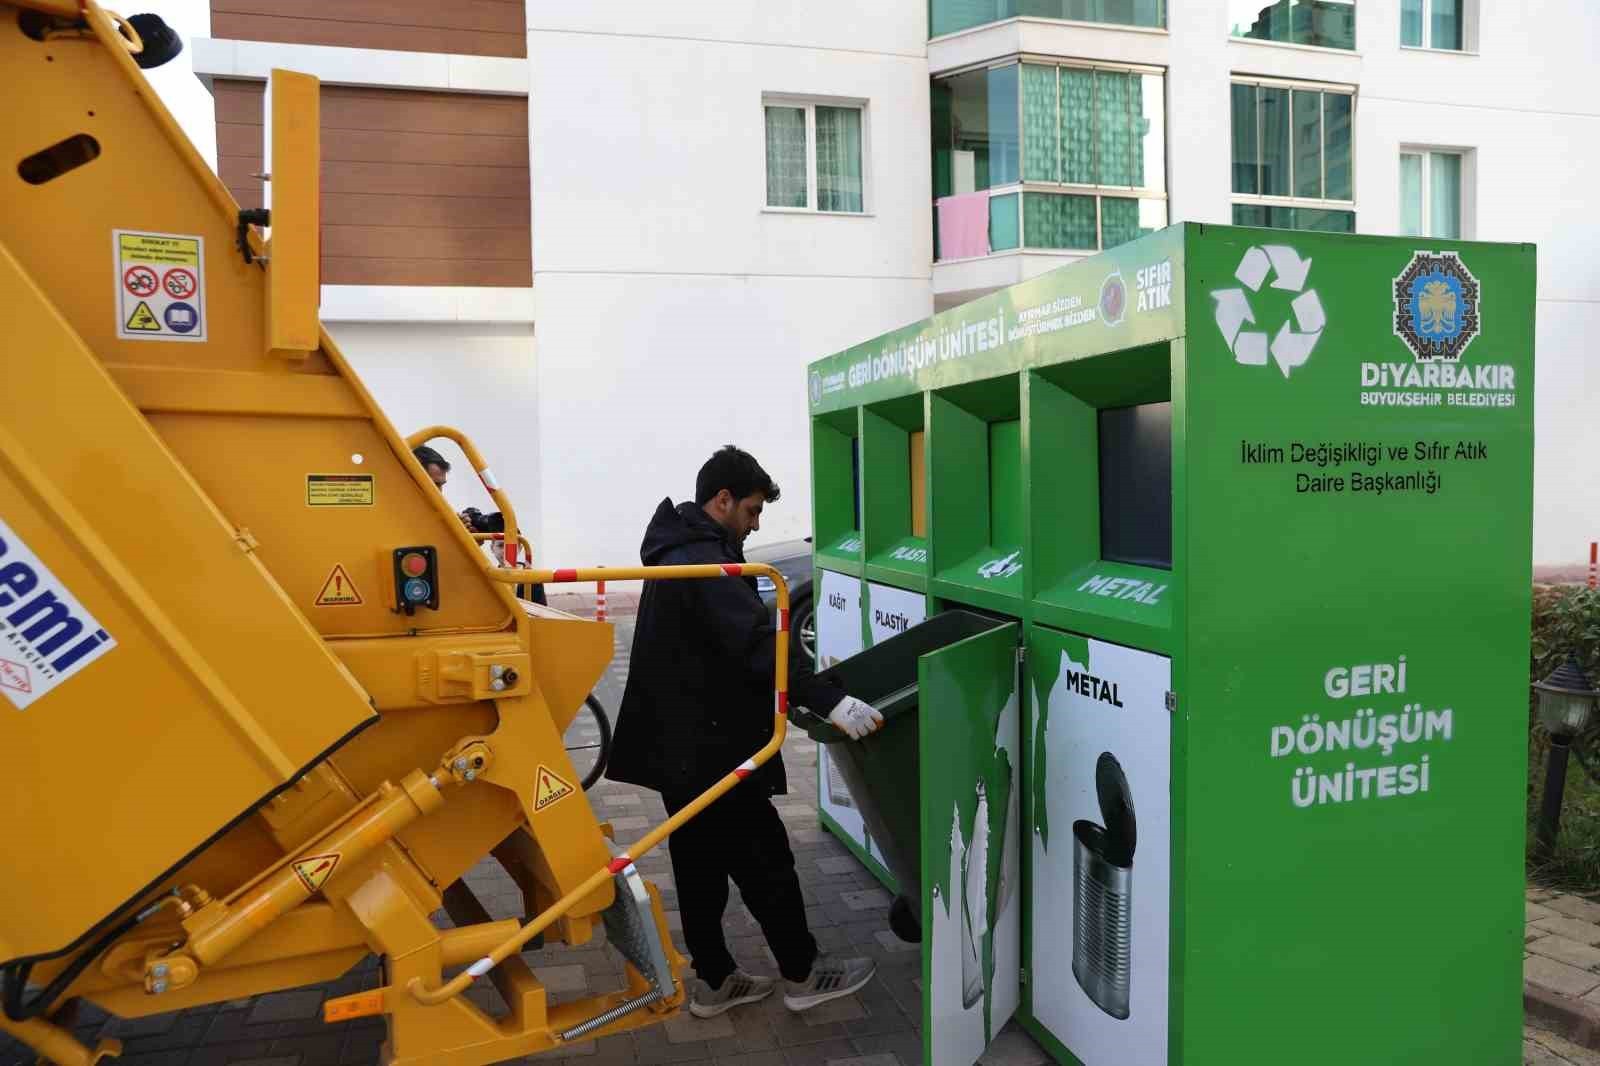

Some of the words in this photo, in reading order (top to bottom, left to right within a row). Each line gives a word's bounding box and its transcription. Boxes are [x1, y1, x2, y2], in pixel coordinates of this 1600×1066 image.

[1136, 260, 1171, 290] SIFIR
[1136, 284, 1171, 312] ATIK
[848, 354, 872, 387] GERİ
[873, 336, 937, 380] DÖNÜŞÜM
[940, 307, 1004, 361] ÜNİTESİ
[1241, 440, 1284, 464] İklim
[1388, 447, 1408, 460] ve
[1414, 441, 1450, 461] Sıfır
[1454, 440, 1488, 460] Atık
[1296, 473, 1345, 493] Daire
[1352, 471, 1441, 495] Başkanlığı
[829, 592, 846, 612] KAĞIT
[1077, 574, 1168, 605] METAL
[875, 609, 909, 631] PLASTİK
[1066, 669, 1123, 708] METAL
[1324, 654, 1407, 699] GERİ
[1270, 703, 1453, 757] DÖNÜŞÜM
[1292, 754, 1430, 808] ÜNİTESİ
